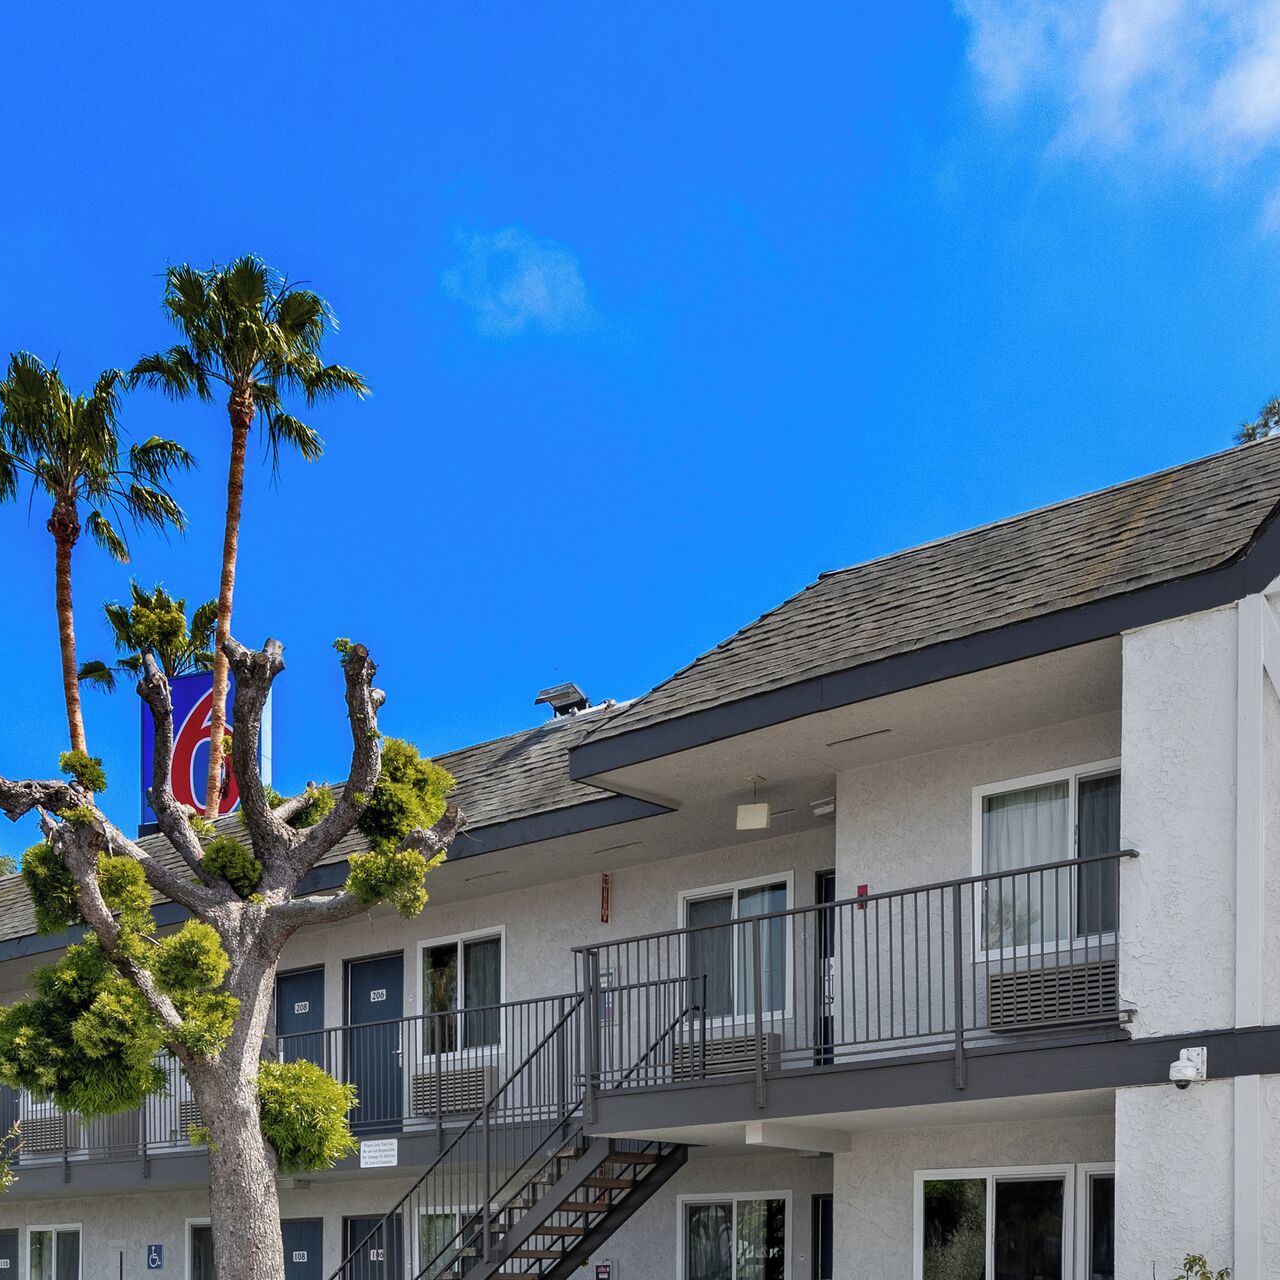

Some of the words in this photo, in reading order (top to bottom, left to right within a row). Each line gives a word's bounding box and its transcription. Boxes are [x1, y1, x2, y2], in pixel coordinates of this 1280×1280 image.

[171, 680, 242, 817] 6
[296, 1003, 308, 1012] 208
[294, 1252, 306, 1261] 108
